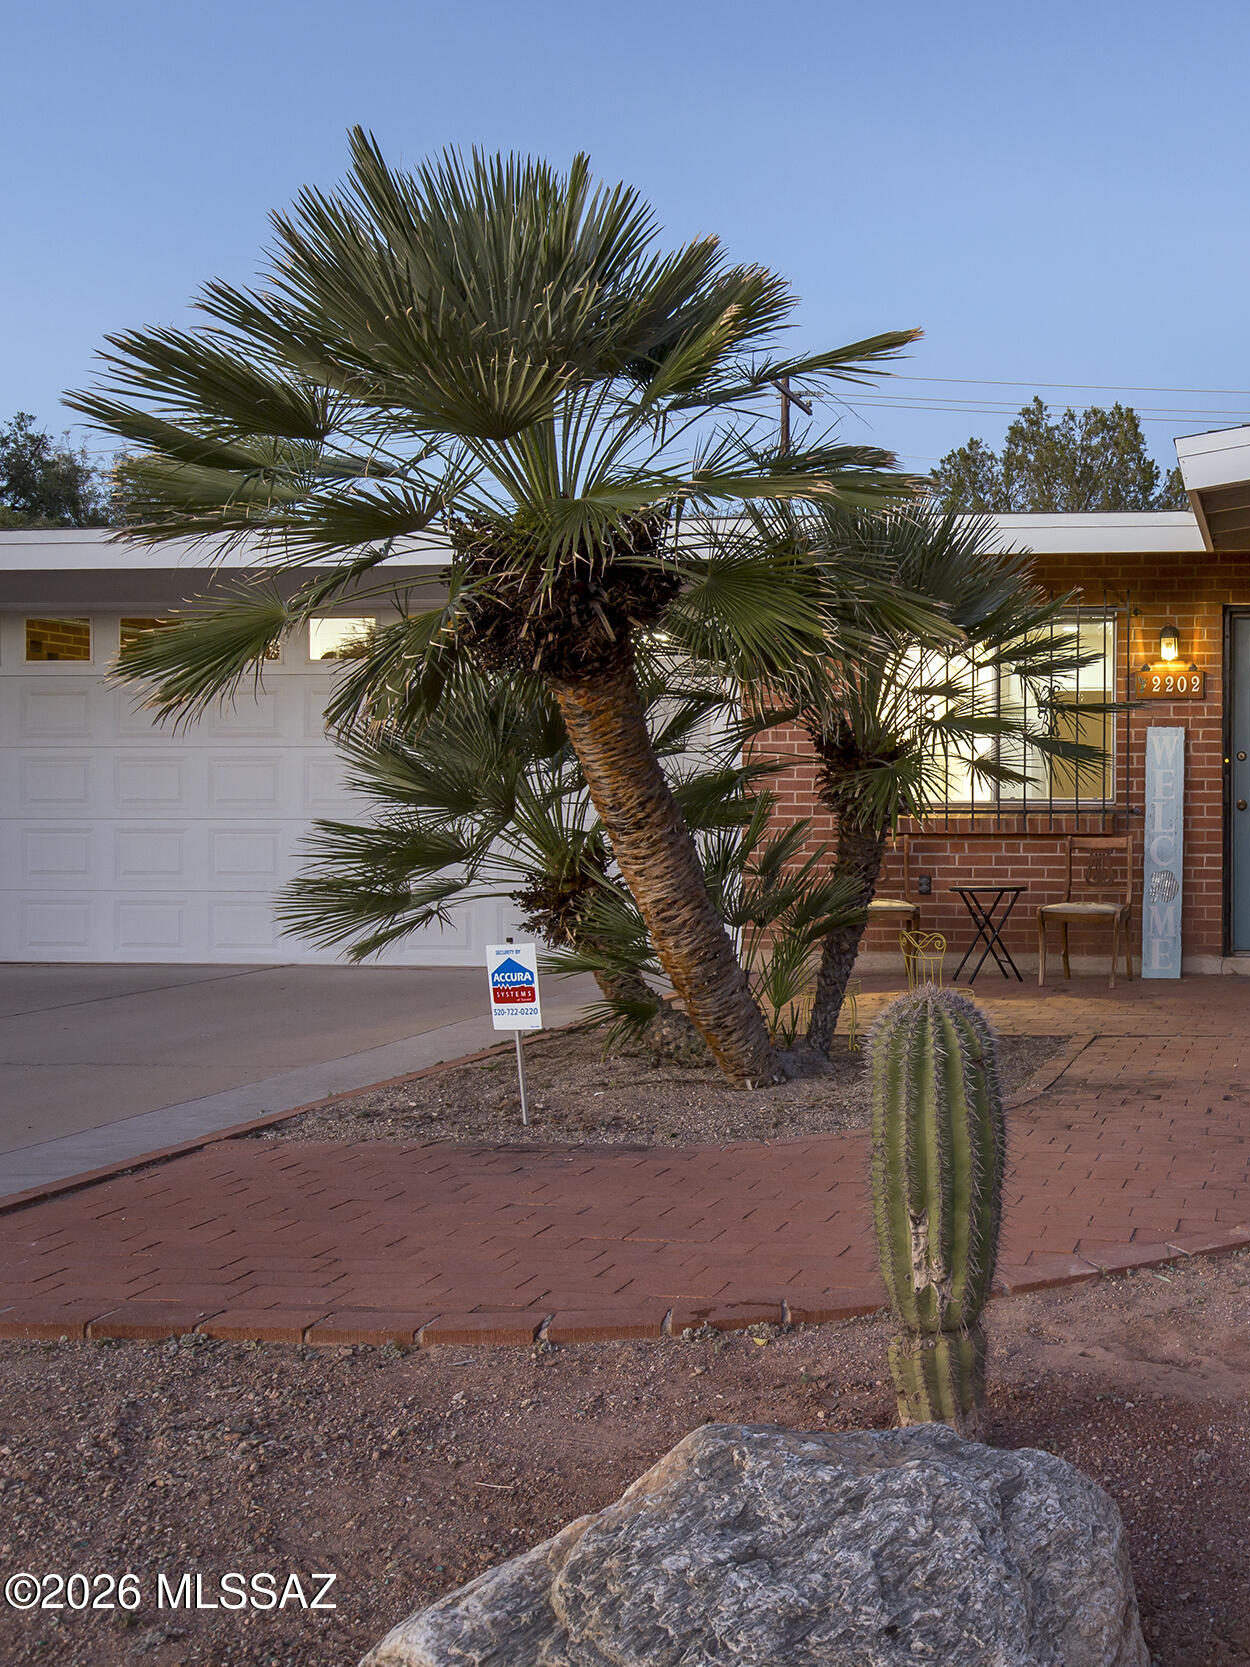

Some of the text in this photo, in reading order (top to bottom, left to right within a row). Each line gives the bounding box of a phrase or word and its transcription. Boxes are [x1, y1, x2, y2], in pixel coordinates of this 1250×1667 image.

[1152, 675, 1200, 693] 2202
[1148, 734, 1179, 970] WELCME
[493, 972, 532, 982] ACCURA
[496, 990, 532, 998] SYSTEMS
[494, 1007, 538, 1016] 520-722-0220
